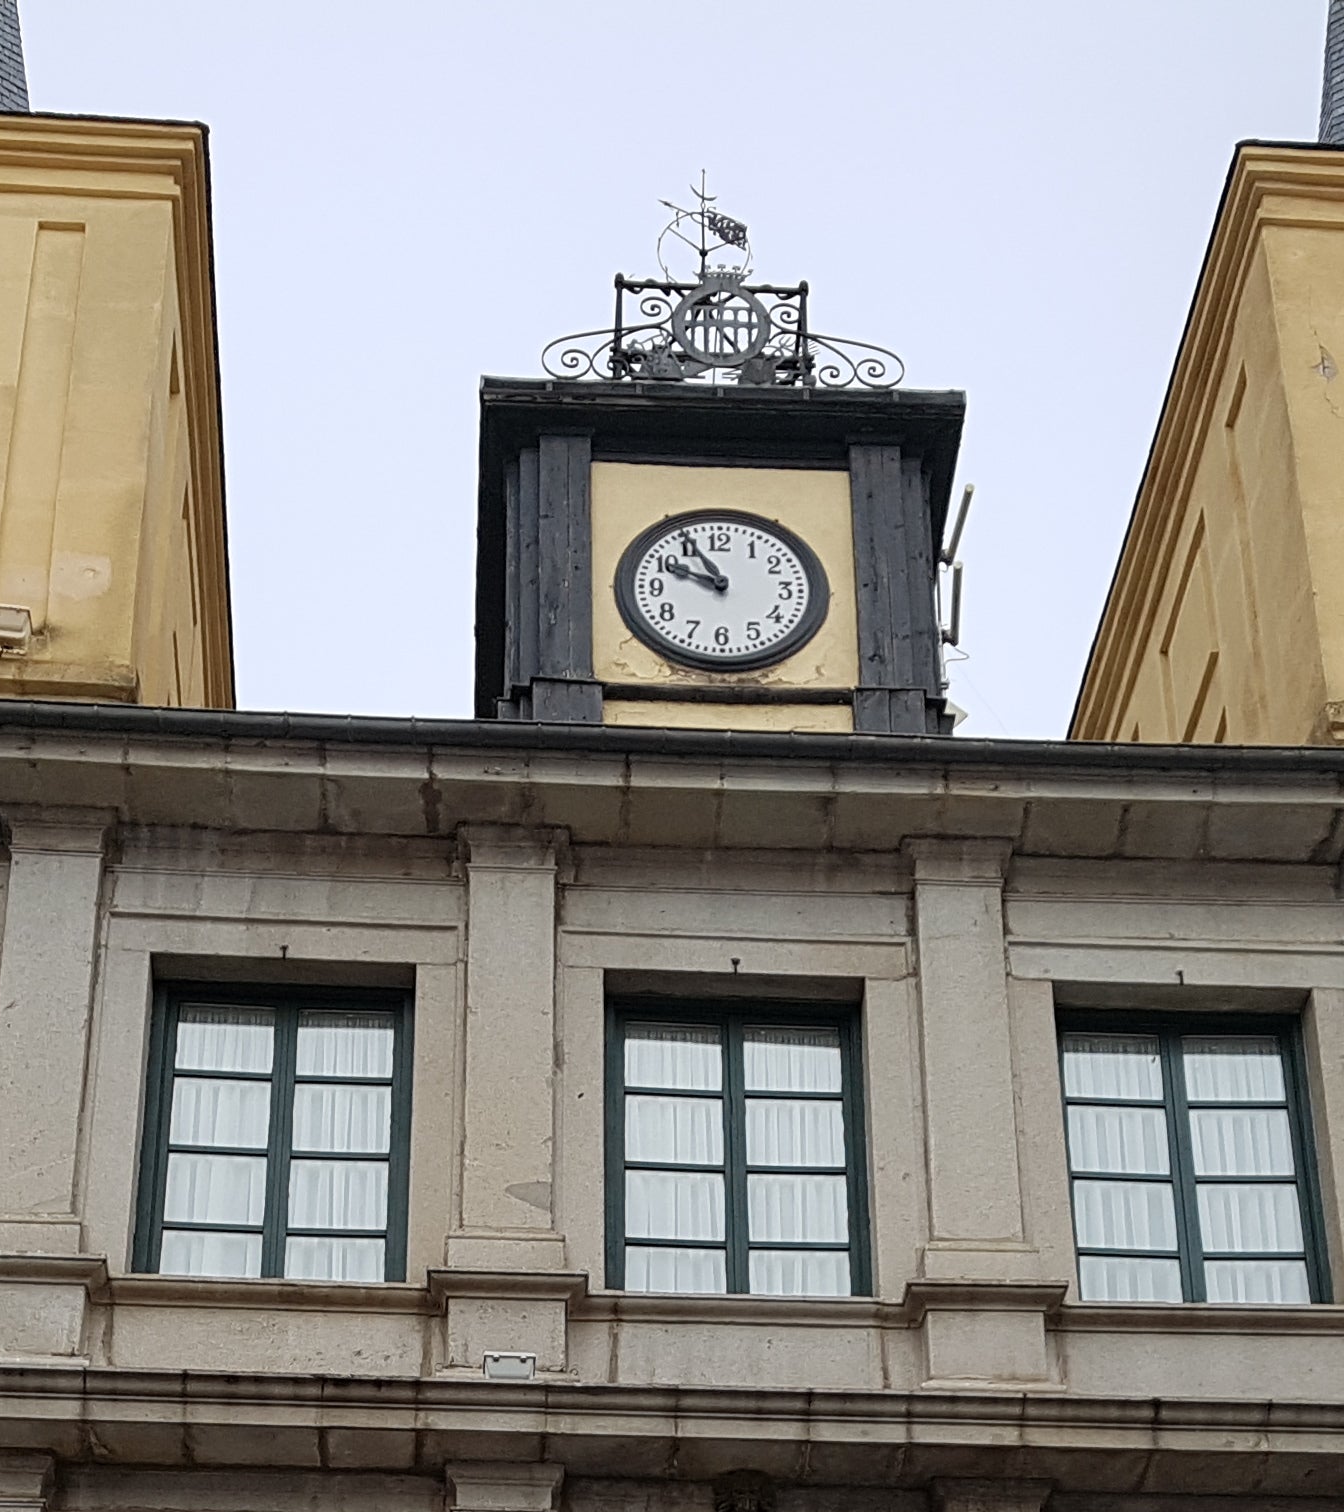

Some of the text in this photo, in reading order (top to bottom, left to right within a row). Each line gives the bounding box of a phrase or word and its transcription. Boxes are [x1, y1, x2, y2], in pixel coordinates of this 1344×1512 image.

[708, 532, 731, 552] 12
[747, 540, 757, 558] 1
[767, 555, 782, 574] 2
[649, 577, 664, 597] 9
[778, 581, 793, 600] 3
[659, 602, 675, 621] 8
[766, 605, 784, 623] 4
[686, 620, 701, 639] 7
[714, 626, 729, 646] 6
[746, 622, 761, 641] 5
